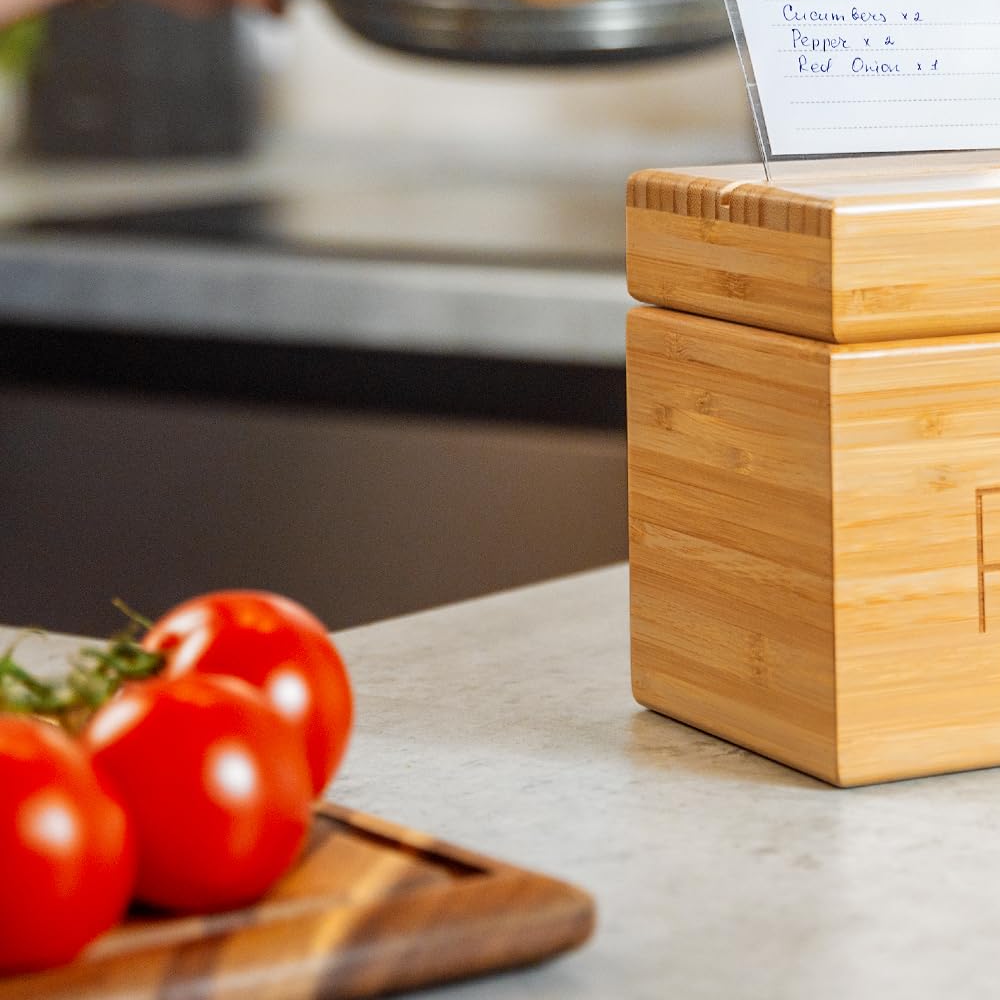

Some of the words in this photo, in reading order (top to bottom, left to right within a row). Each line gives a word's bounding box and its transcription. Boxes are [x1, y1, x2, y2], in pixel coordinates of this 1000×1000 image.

[782, 4, 888, 23] Cucumbers
[914, 10, 923, 22] 2
[791, 28, 851, 52] Pepper
[798, 55, 833, 73] Red
[851, 57, 901, 73] Onion
